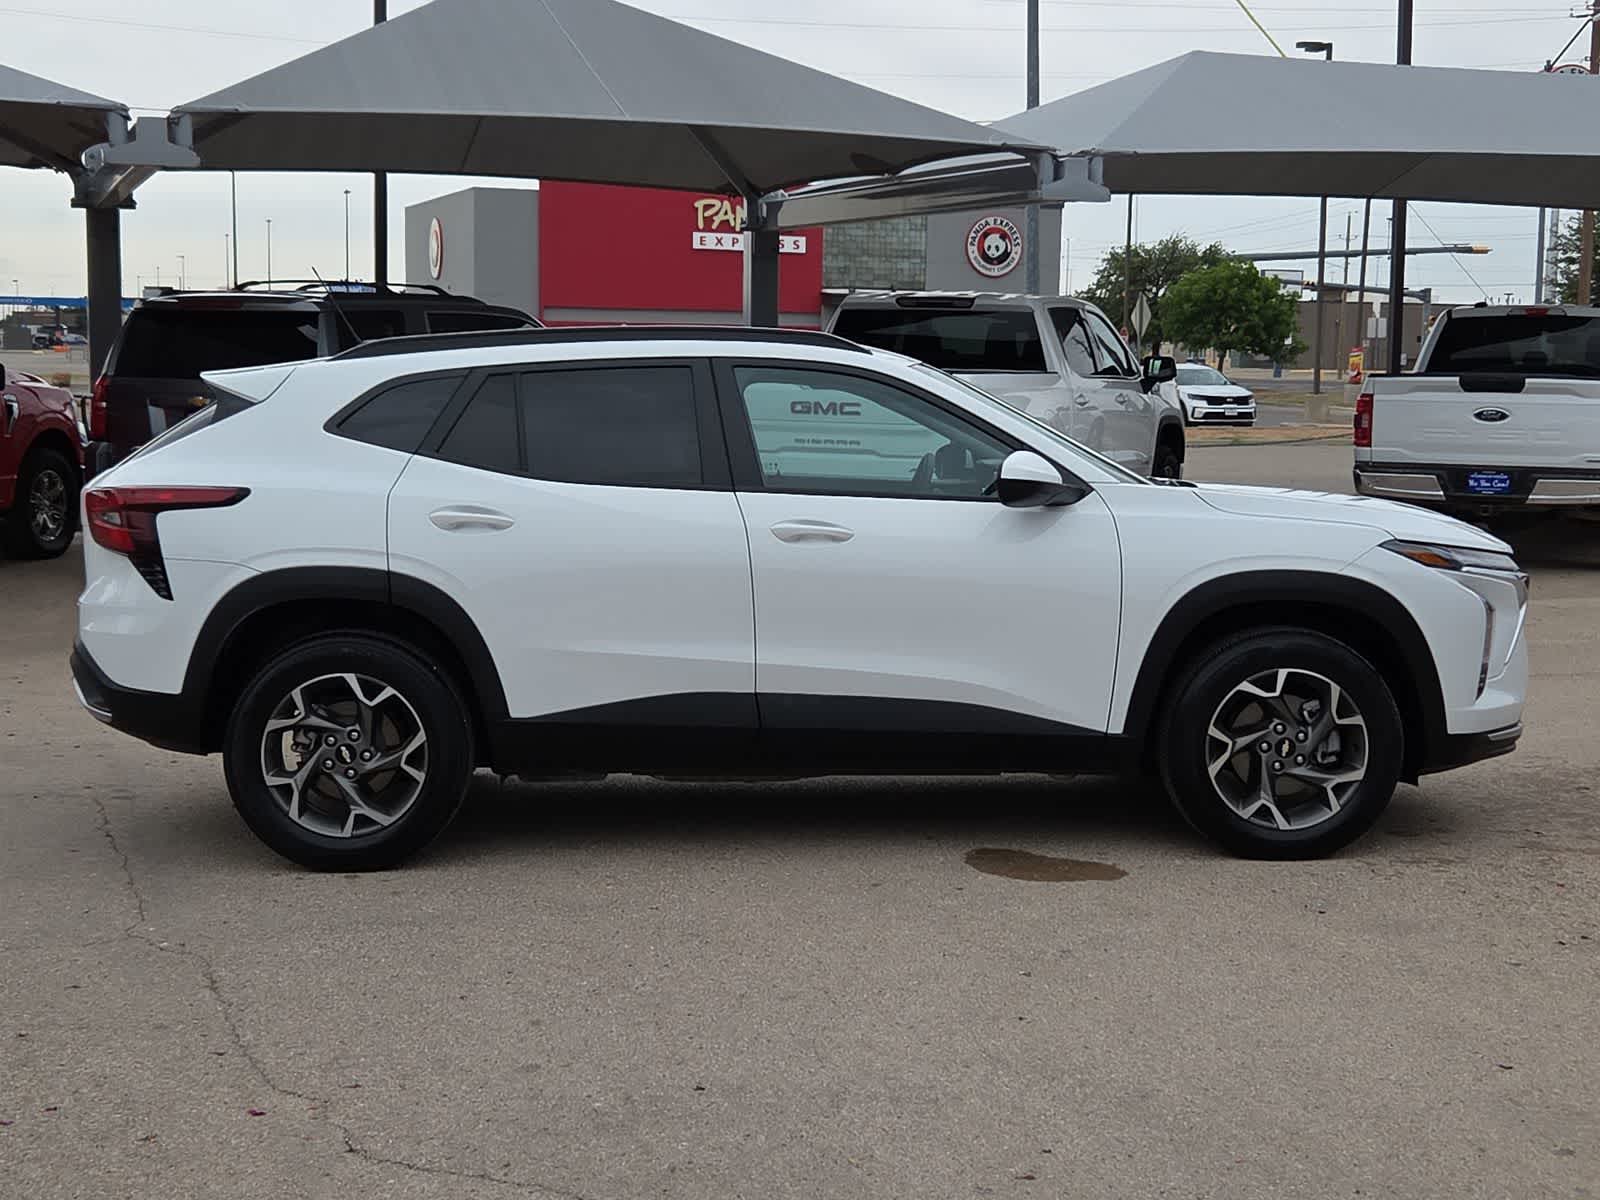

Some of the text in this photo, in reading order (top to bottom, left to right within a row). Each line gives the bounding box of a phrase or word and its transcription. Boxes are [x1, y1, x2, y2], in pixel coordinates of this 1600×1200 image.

[969, 218, 1020, 248] PANDA EXPRESS
[699, 235, 800, 250] EXPSS
[790, 400, 861, 416] GMC
